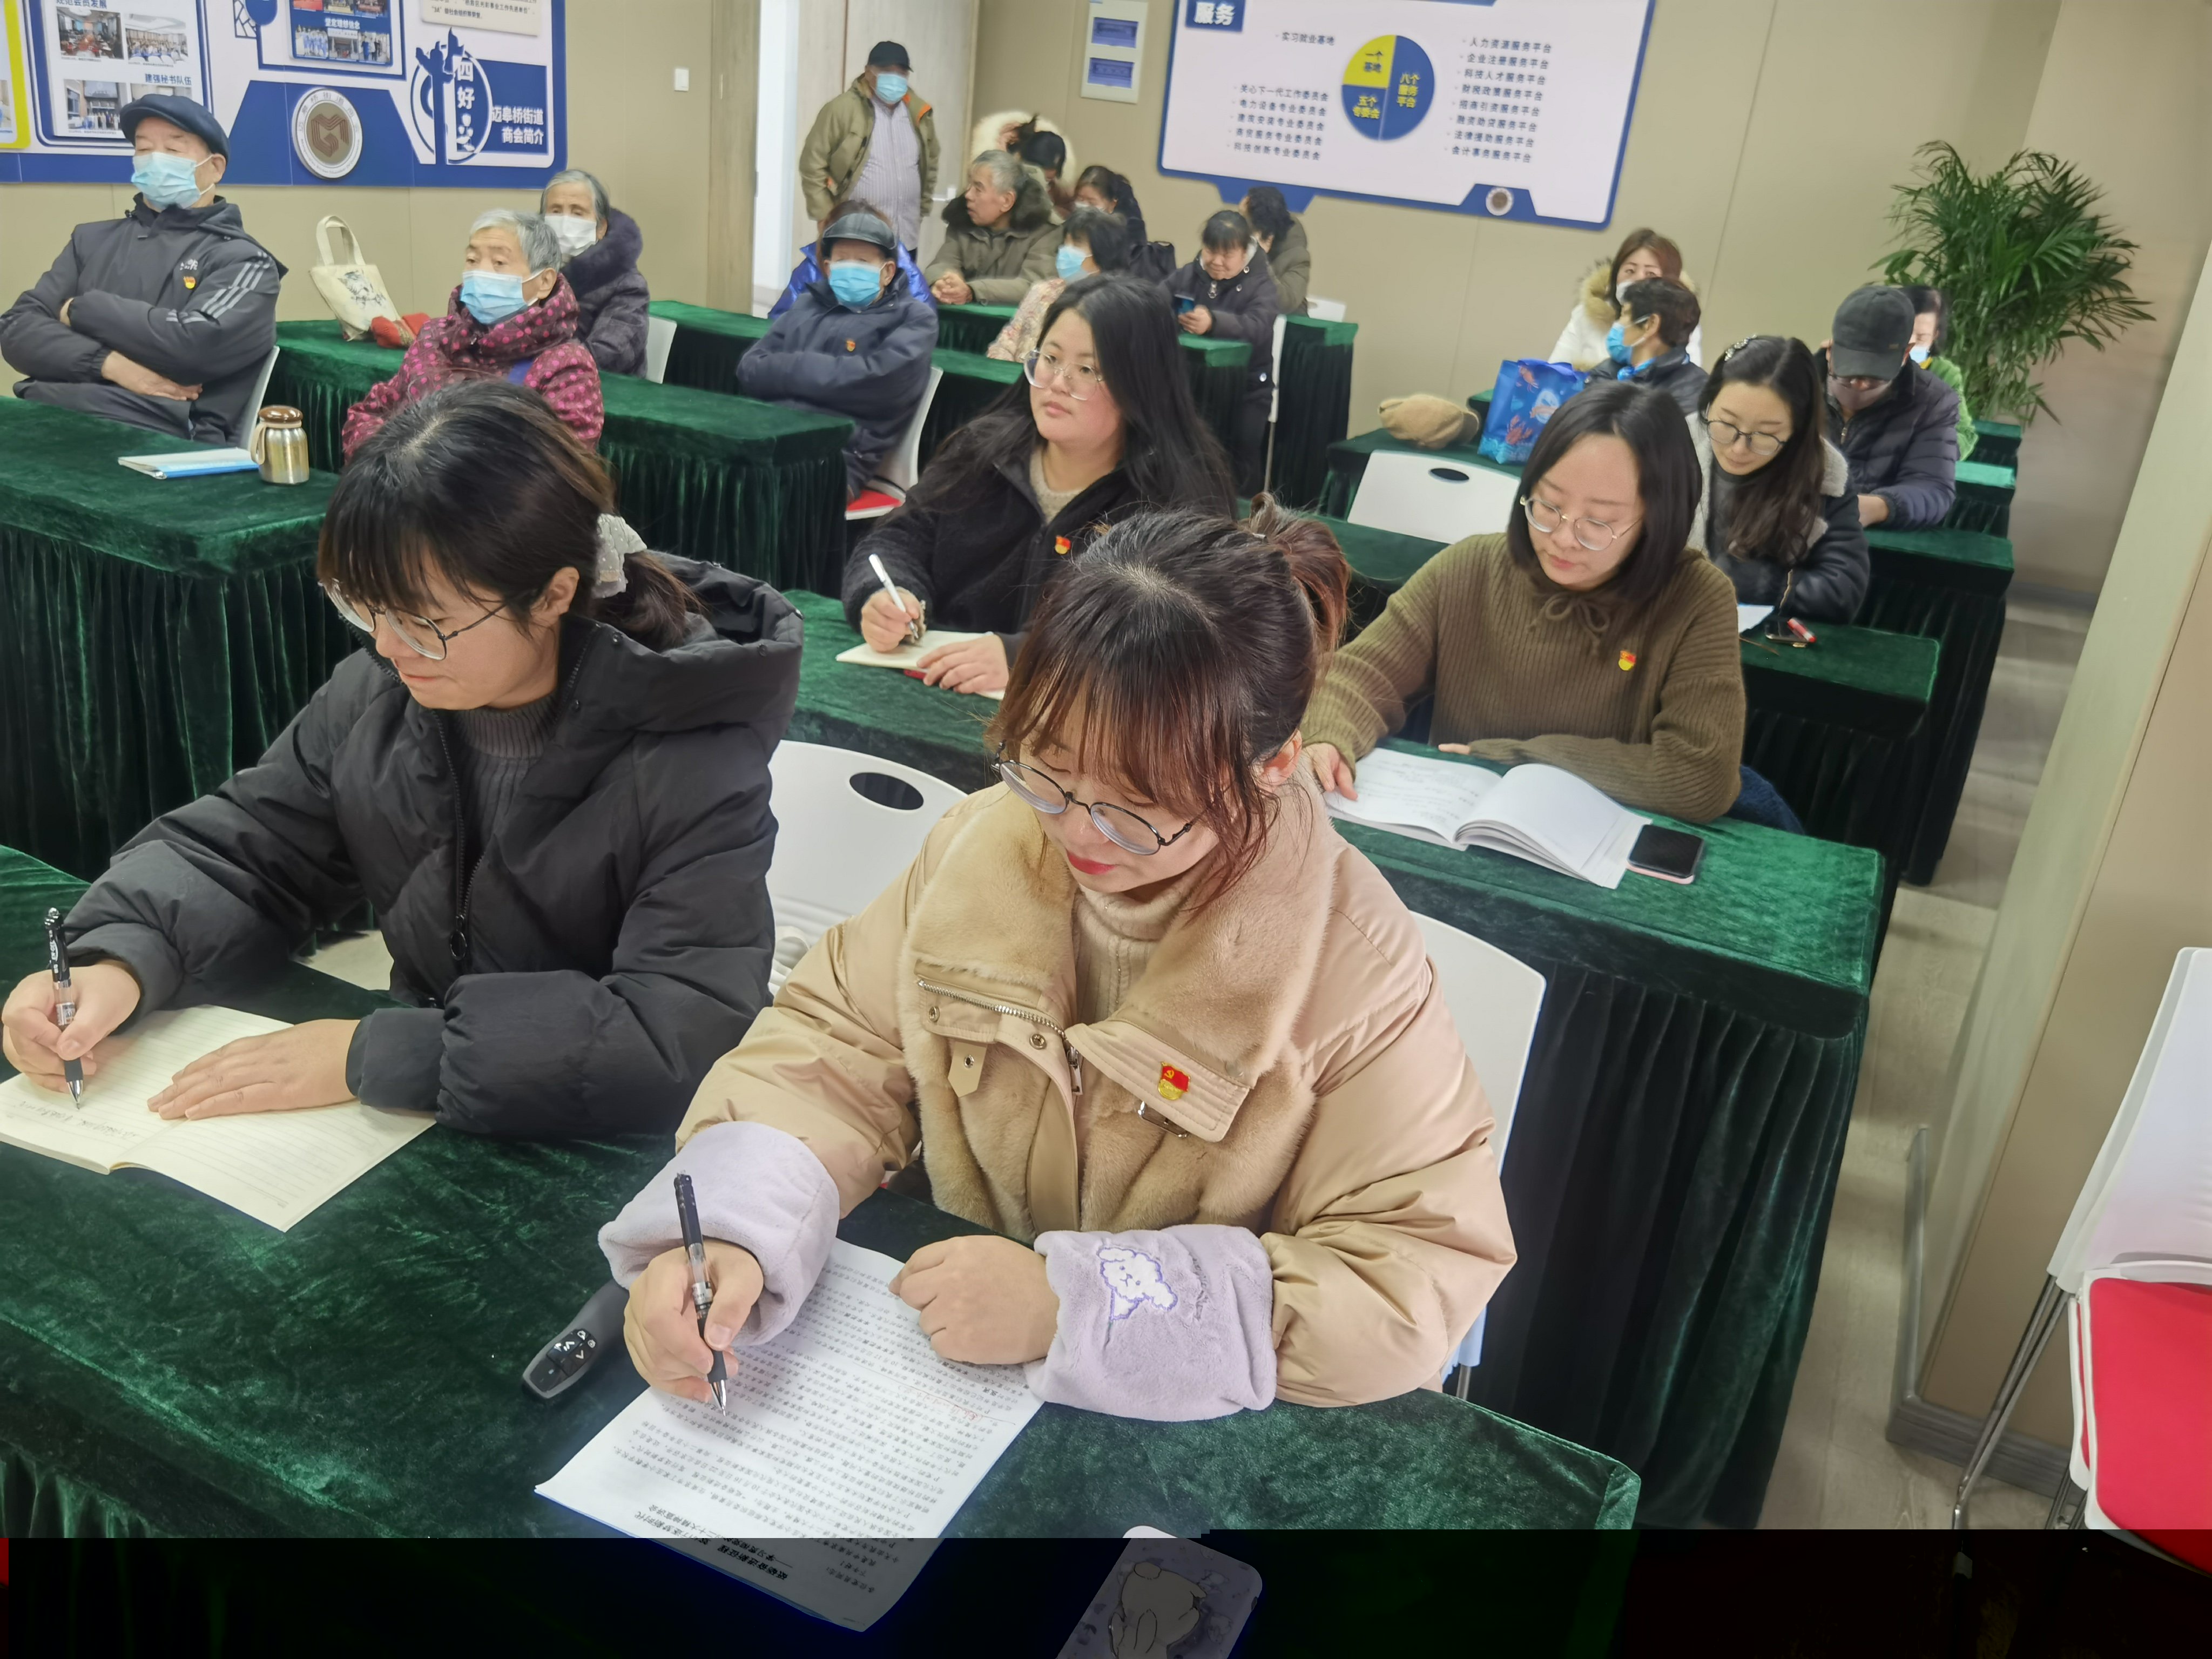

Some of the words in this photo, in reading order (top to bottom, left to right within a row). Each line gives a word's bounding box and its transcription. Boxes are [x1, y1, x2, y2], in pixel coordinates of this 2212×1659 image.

[1193, 1, 1235, 25] 服务
[1281, 31, 1335, 45] 实习就业基地
[1469, 37, 1552, 53] 人力资源服务平台
[1365, 50, 1383, 60] 一个
[1467, 52, 1548, 70] 企业注册服务平台
[1364, 62, 1381, 73] 基地
[1464, 68, 1546, 85] 科技人才服务平台
[145, 73, 192, 85] 建强秘书队伍
[457, 60, 475, 110] 四好
[1399, 72, 1420, 85] 八个
[1240, 84, 1328, 102] 关心下一代工作委员会
[1398, 84, 1418, 97] 服务
[1461, 83, 1543, 101] 财税政策服务平台
[1240, 99, 1327, 117] 电力设备专业委员会
[1357, 95, 1377, 107] 五个
[1396, 96, 1417, 109] 平台
[1459, 99, 1540, 117] 招商引资服务平台
[491, 104, 544, 125] 迈皋桥街道
[1237, 113, 1324, 131] 建筑安装专业委员会
[1352, 106, 1380, 120] 专委会
[1456, 114, 1537, 132] 融资助贷服务平台
[501, 125, 544, 146] 商会简介
[1236, 127, 1322, 146] 商贸服务专业委员会
[1454, 130, 1534, 147] 法律援助服务平台
[1234, 141, 1320, 161] 科技创新专业委员会
[1452, 145, 1531, 163] 会计事务服务平台
